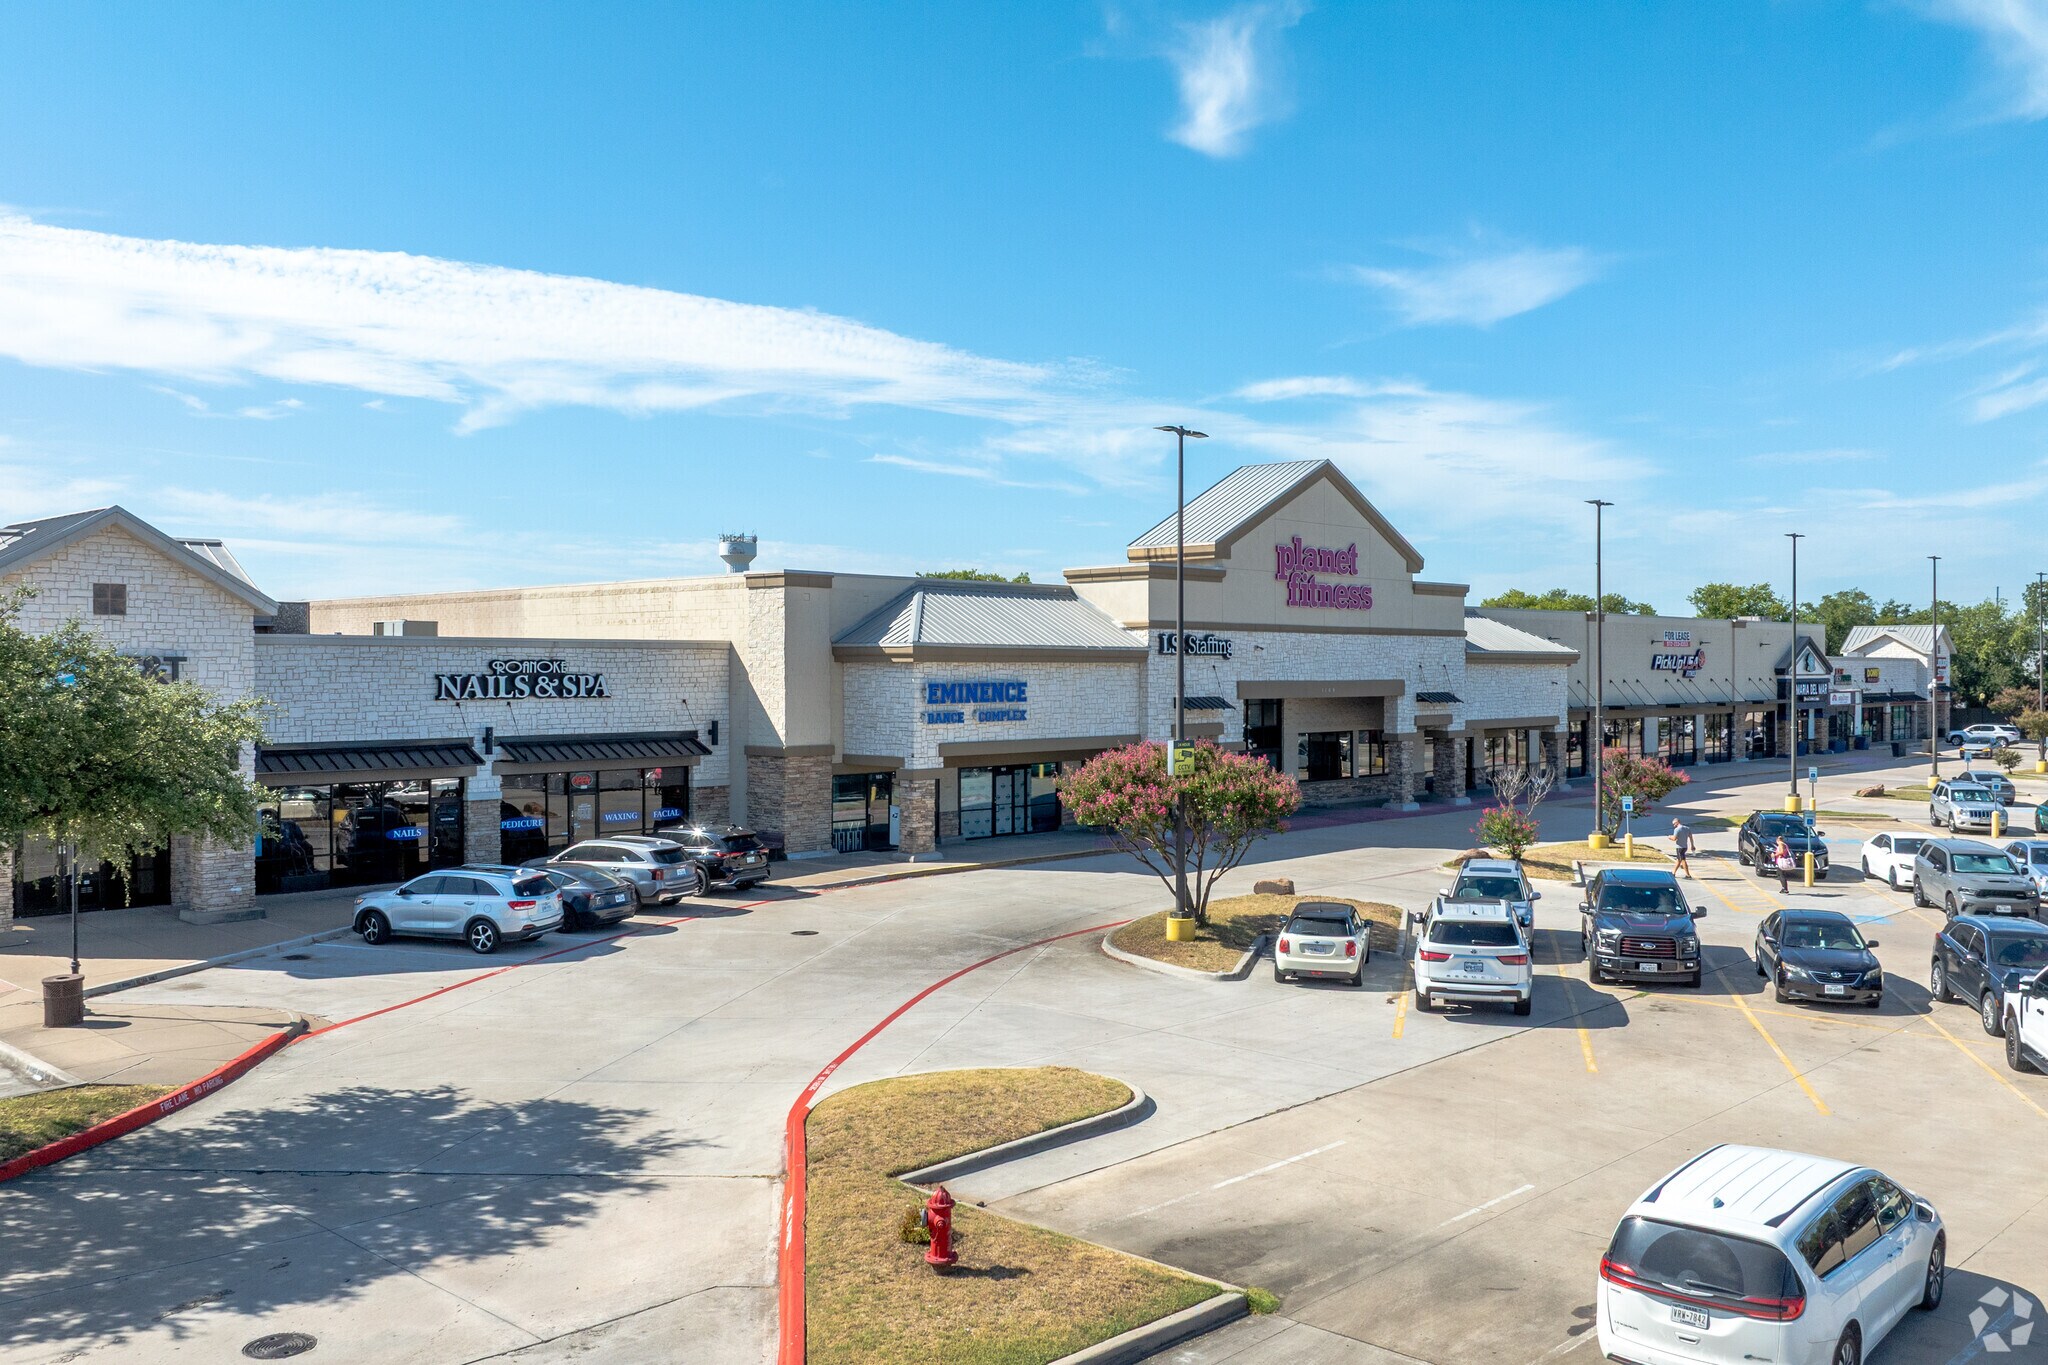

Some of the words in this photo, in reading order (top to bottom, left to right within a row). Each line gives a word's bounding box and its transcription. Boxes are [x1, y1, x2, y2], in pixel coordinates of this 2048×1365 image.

[1276, 536, 1358, 581] planet
[1288, 571, 1373, 610] fitness
[1664, 631, 1675, 641] FOR
[1676, 631, 1690, 641] LEASE
[1162, 633, 1185, 654] LS
[1188, 635, 1233, 659] Staffing
[492, 660, 567, 675] ROANOKE
[438, 675, 530, 700] NAILS
[534, 675, 559, 698] &
[562, 673, 612, 698] SPA
[926, 681, 1028, 704] EMINENCE
[926, 711, 965, 724] DANCE
[978, 709, 1028, 722] COMPLEX
[604, 811, 639, 822] WAXING
[653, 808, 681, 819] FACIAL
[500, 818, 544, 830] PEDICURE
[393, 828, 422, 839] NAILS
[160, 1101, 174, 1112] FIRE
[174, 1091, 190, 1105] LANE
[202, 1075, 223, 1092] PARKING
[1673, 1309, 1705, 1324] VRW-7842
